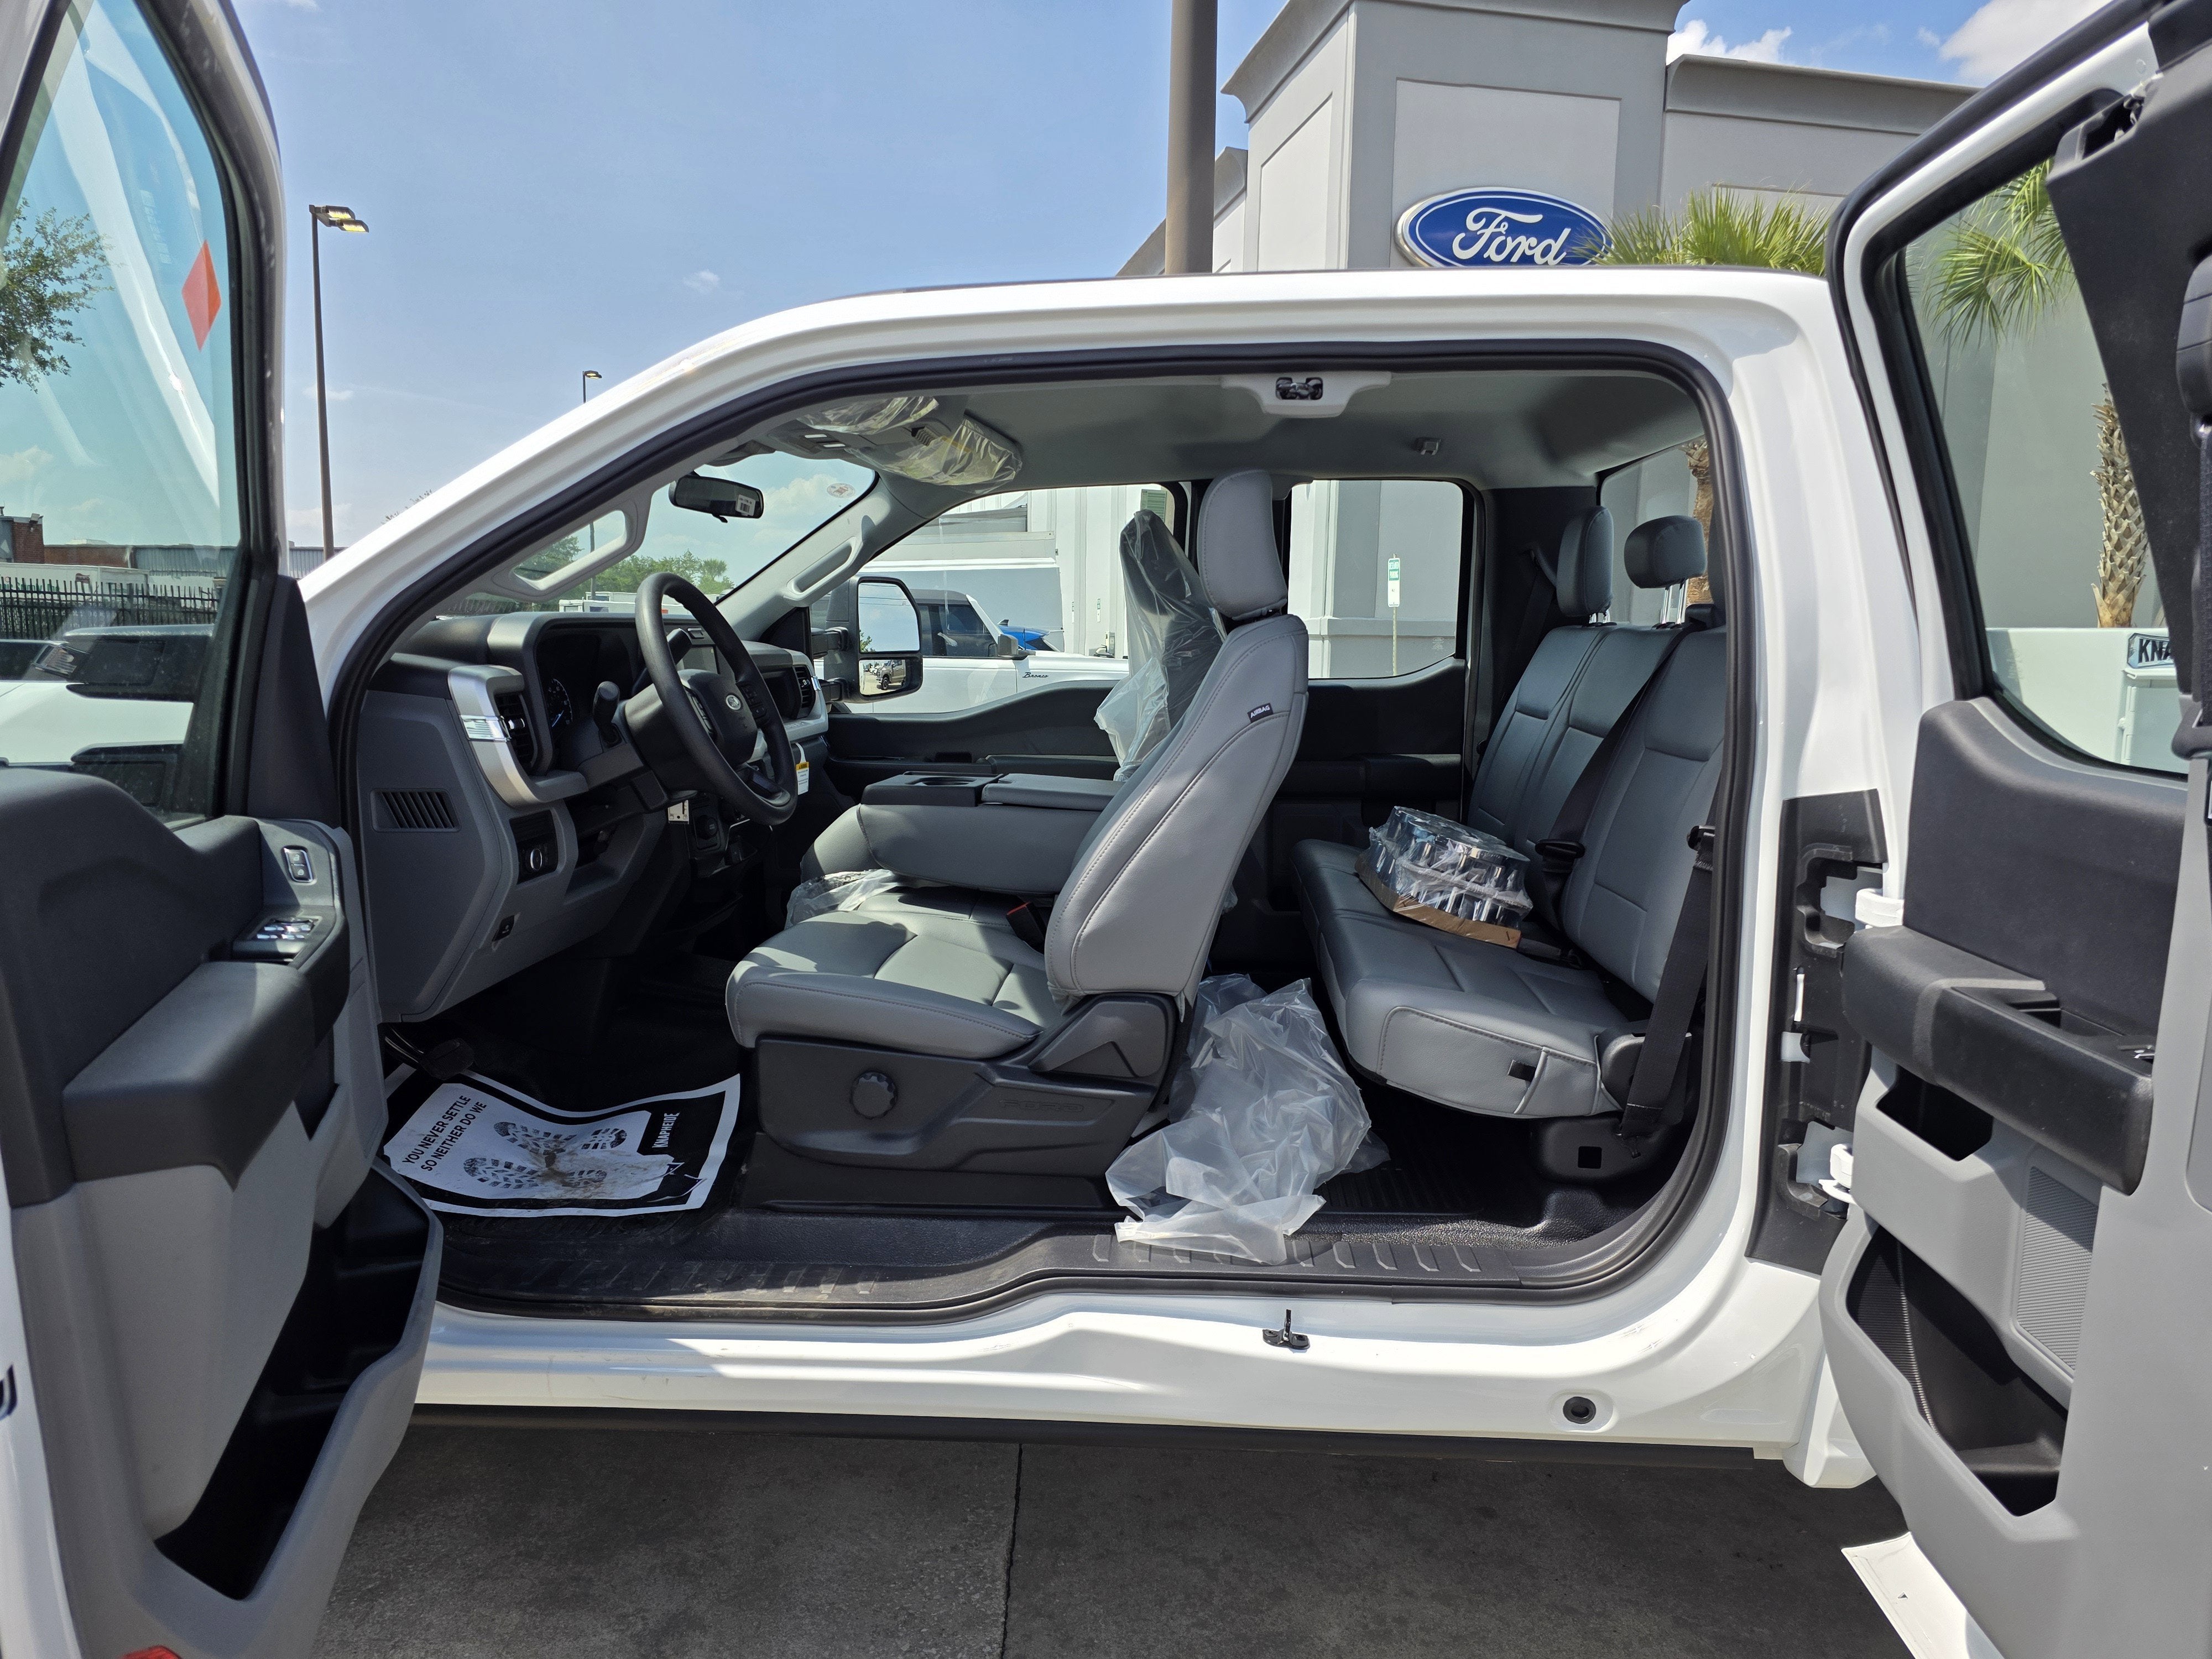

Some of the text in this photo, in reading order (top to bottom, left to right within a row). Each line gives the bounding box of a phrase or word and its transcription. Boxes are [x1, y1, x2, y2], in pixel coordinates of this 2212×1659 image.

[1452, 207, 1572, 266] Ford
[1250, 705, 1270, 718] AIRBAG
[402, 1095, 471, 1164] YOU NEVER SETTLE
[420, 1102, 487, 1171] SO NEITHER DO WE
[652, 1112, 681, 1148] KNAPHEIDE
